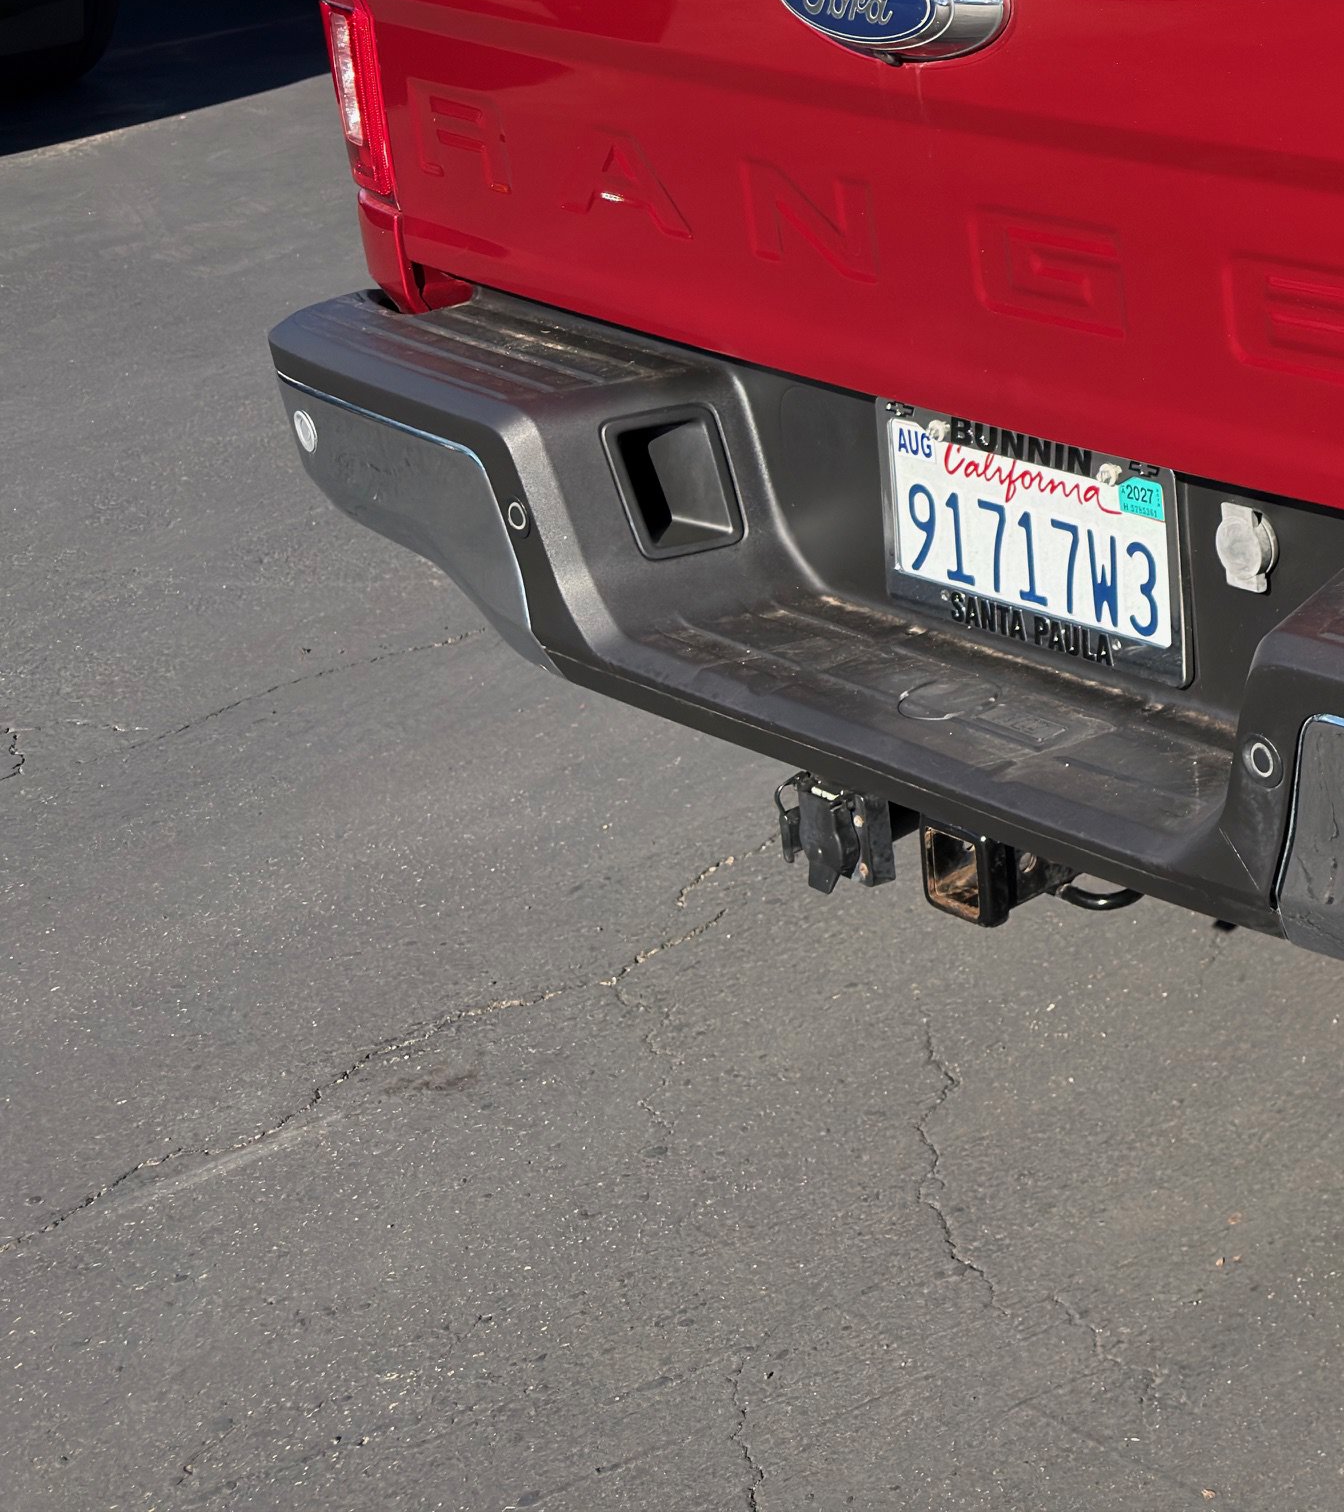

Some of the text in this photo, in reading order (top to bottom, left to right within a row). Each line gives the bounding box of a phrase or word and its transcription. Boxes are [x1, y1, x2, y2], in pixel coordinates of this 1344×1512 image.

[897, 427, 933, 459] AUG
[950, 416, 1093, 477] BUNNIN
[944, 441, 1122, 515] California
[1126, 484, 1154, 505] 2027
[907, 482, 1159, 637] 91717W3
[950, 590, 1115, 667] SANTA PAULA
